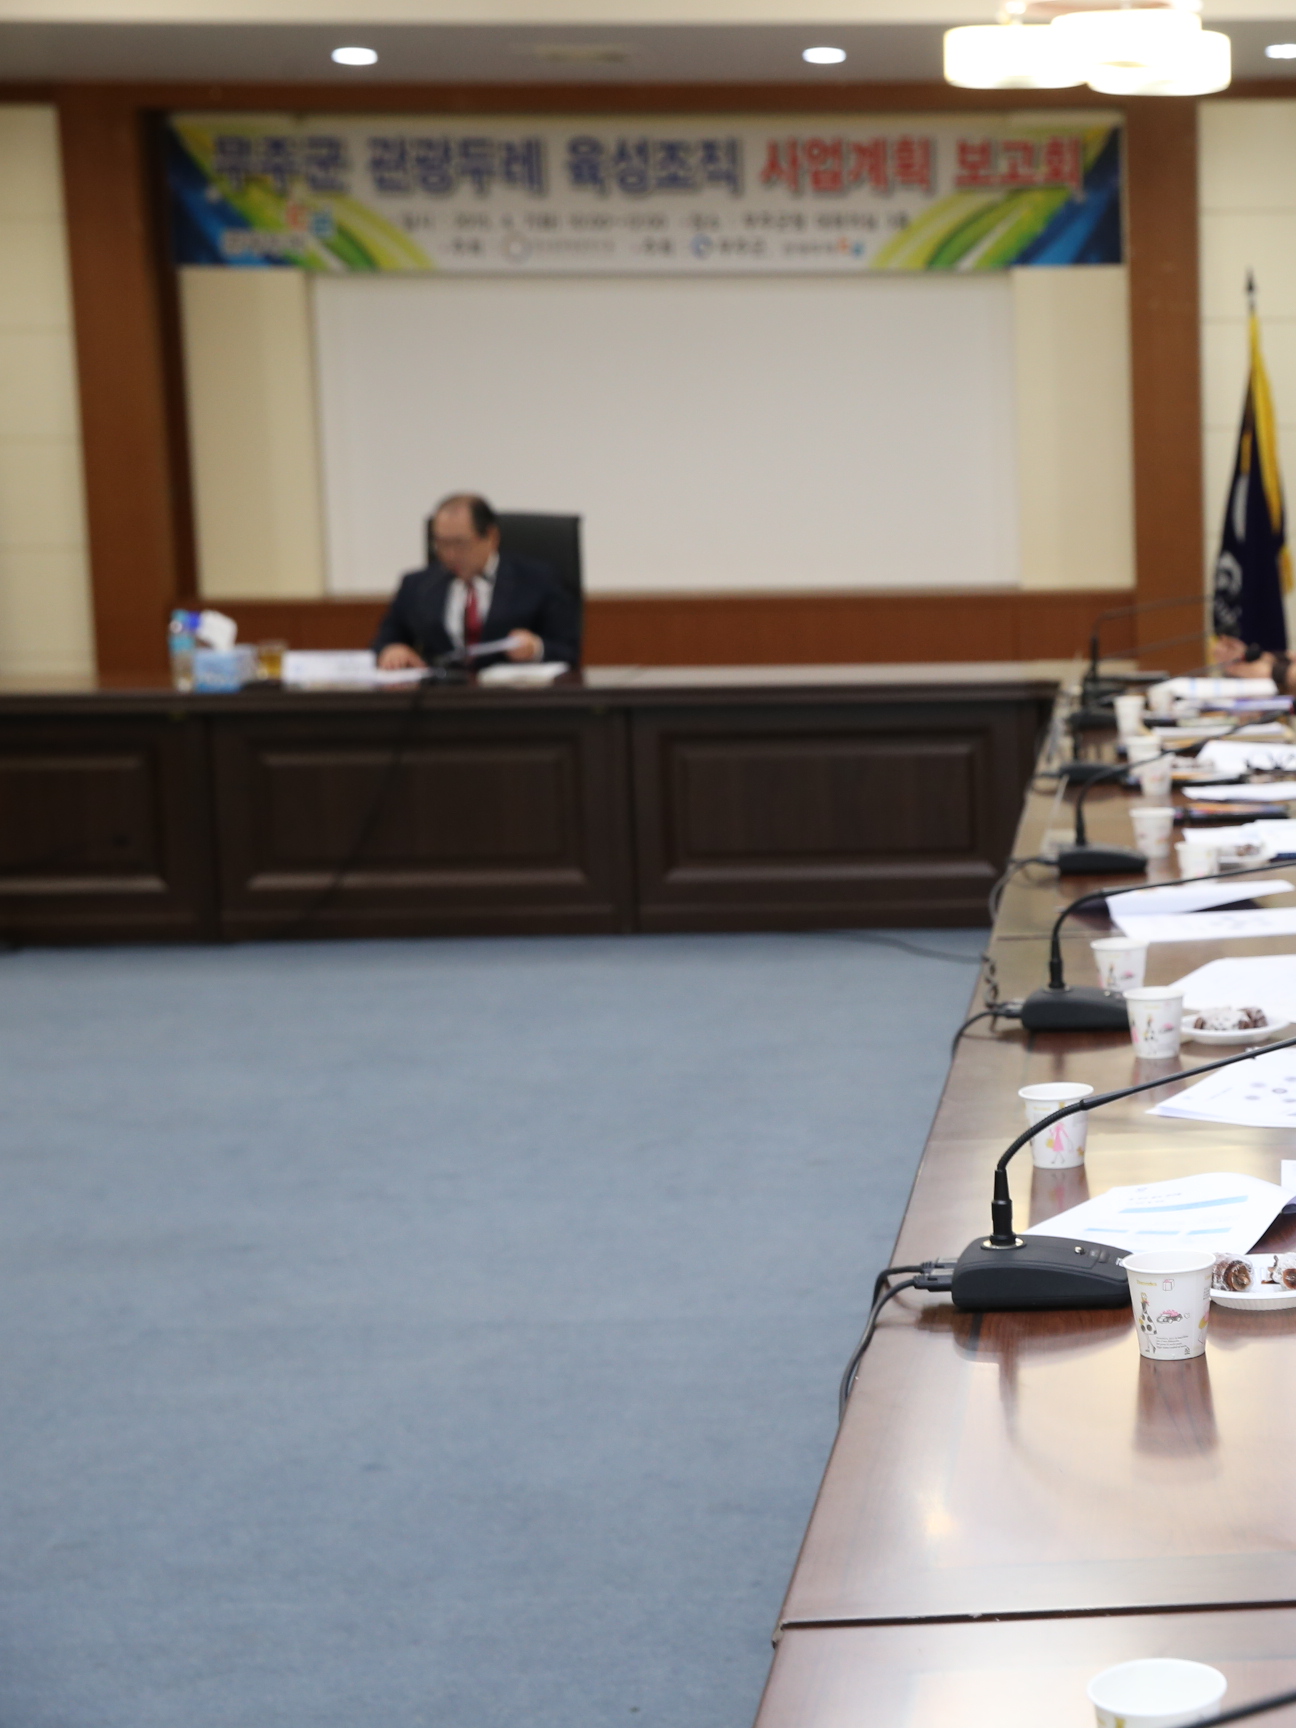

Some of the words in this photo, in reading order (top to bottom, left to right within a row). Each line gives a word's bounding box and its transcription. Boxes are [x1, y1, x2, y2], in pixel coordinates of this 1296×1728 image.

[213, 135, 348, 194] 무주군
[367, 135, 545, 196] 관광두레
[565, 135, 739, 196] 육성조직
[760, 135, 934, 194] 사업계획
[953, 135, 1082, 191] 보고회
